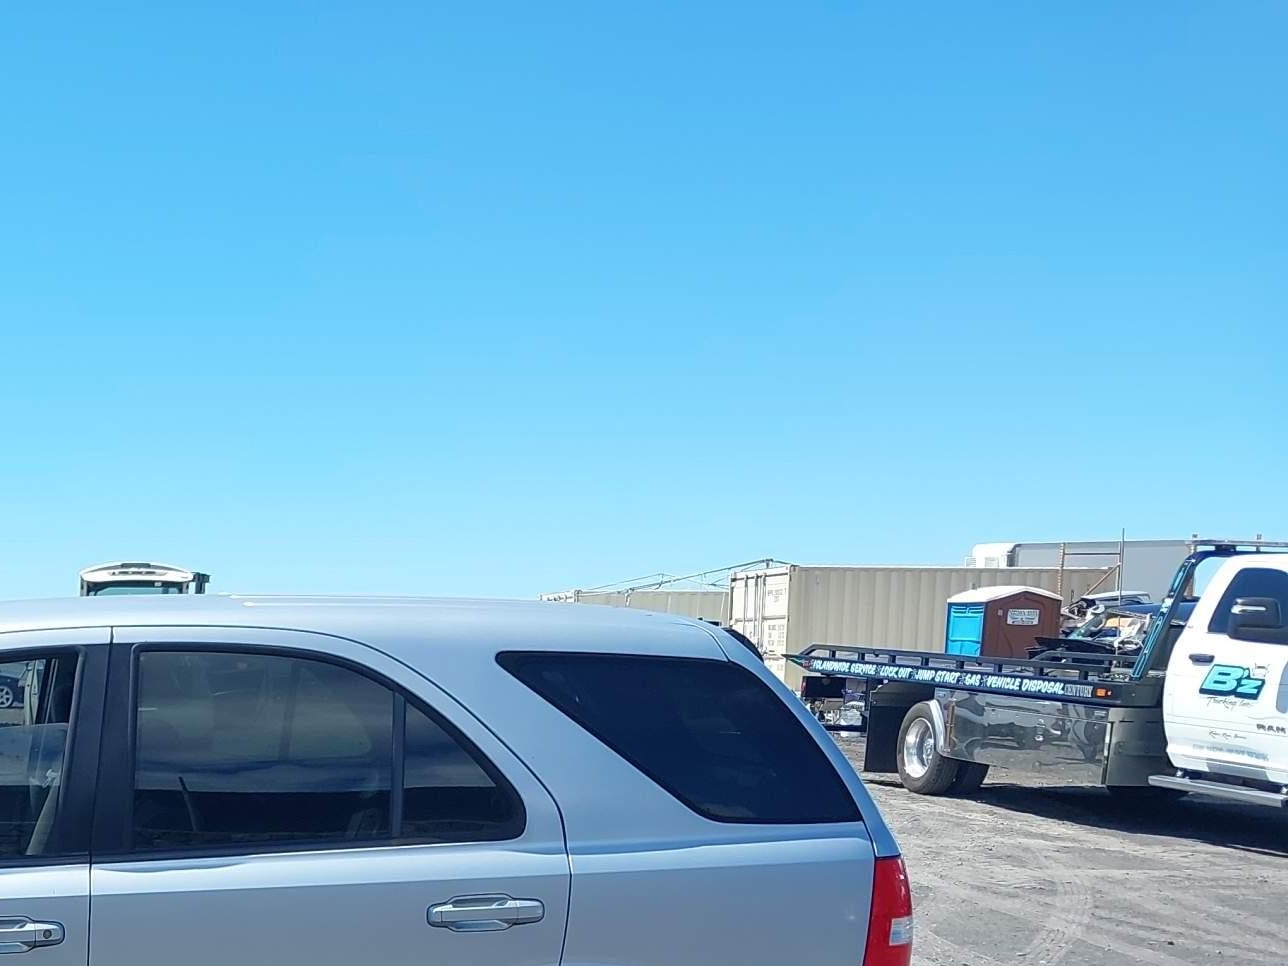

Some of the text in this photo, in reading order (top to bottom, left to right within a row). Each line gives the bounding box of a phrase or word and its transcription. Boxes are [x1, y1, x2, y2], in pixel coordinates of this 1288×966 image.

[813, 659, 1064, 695] ISLANDWIDE SERVICE LOCK OUT JUMP START GAS VEHICLE DISPOSAL
[1064, 684, 1093, 697] CENTURY
[1256, 724, 1287, 734] RAM
